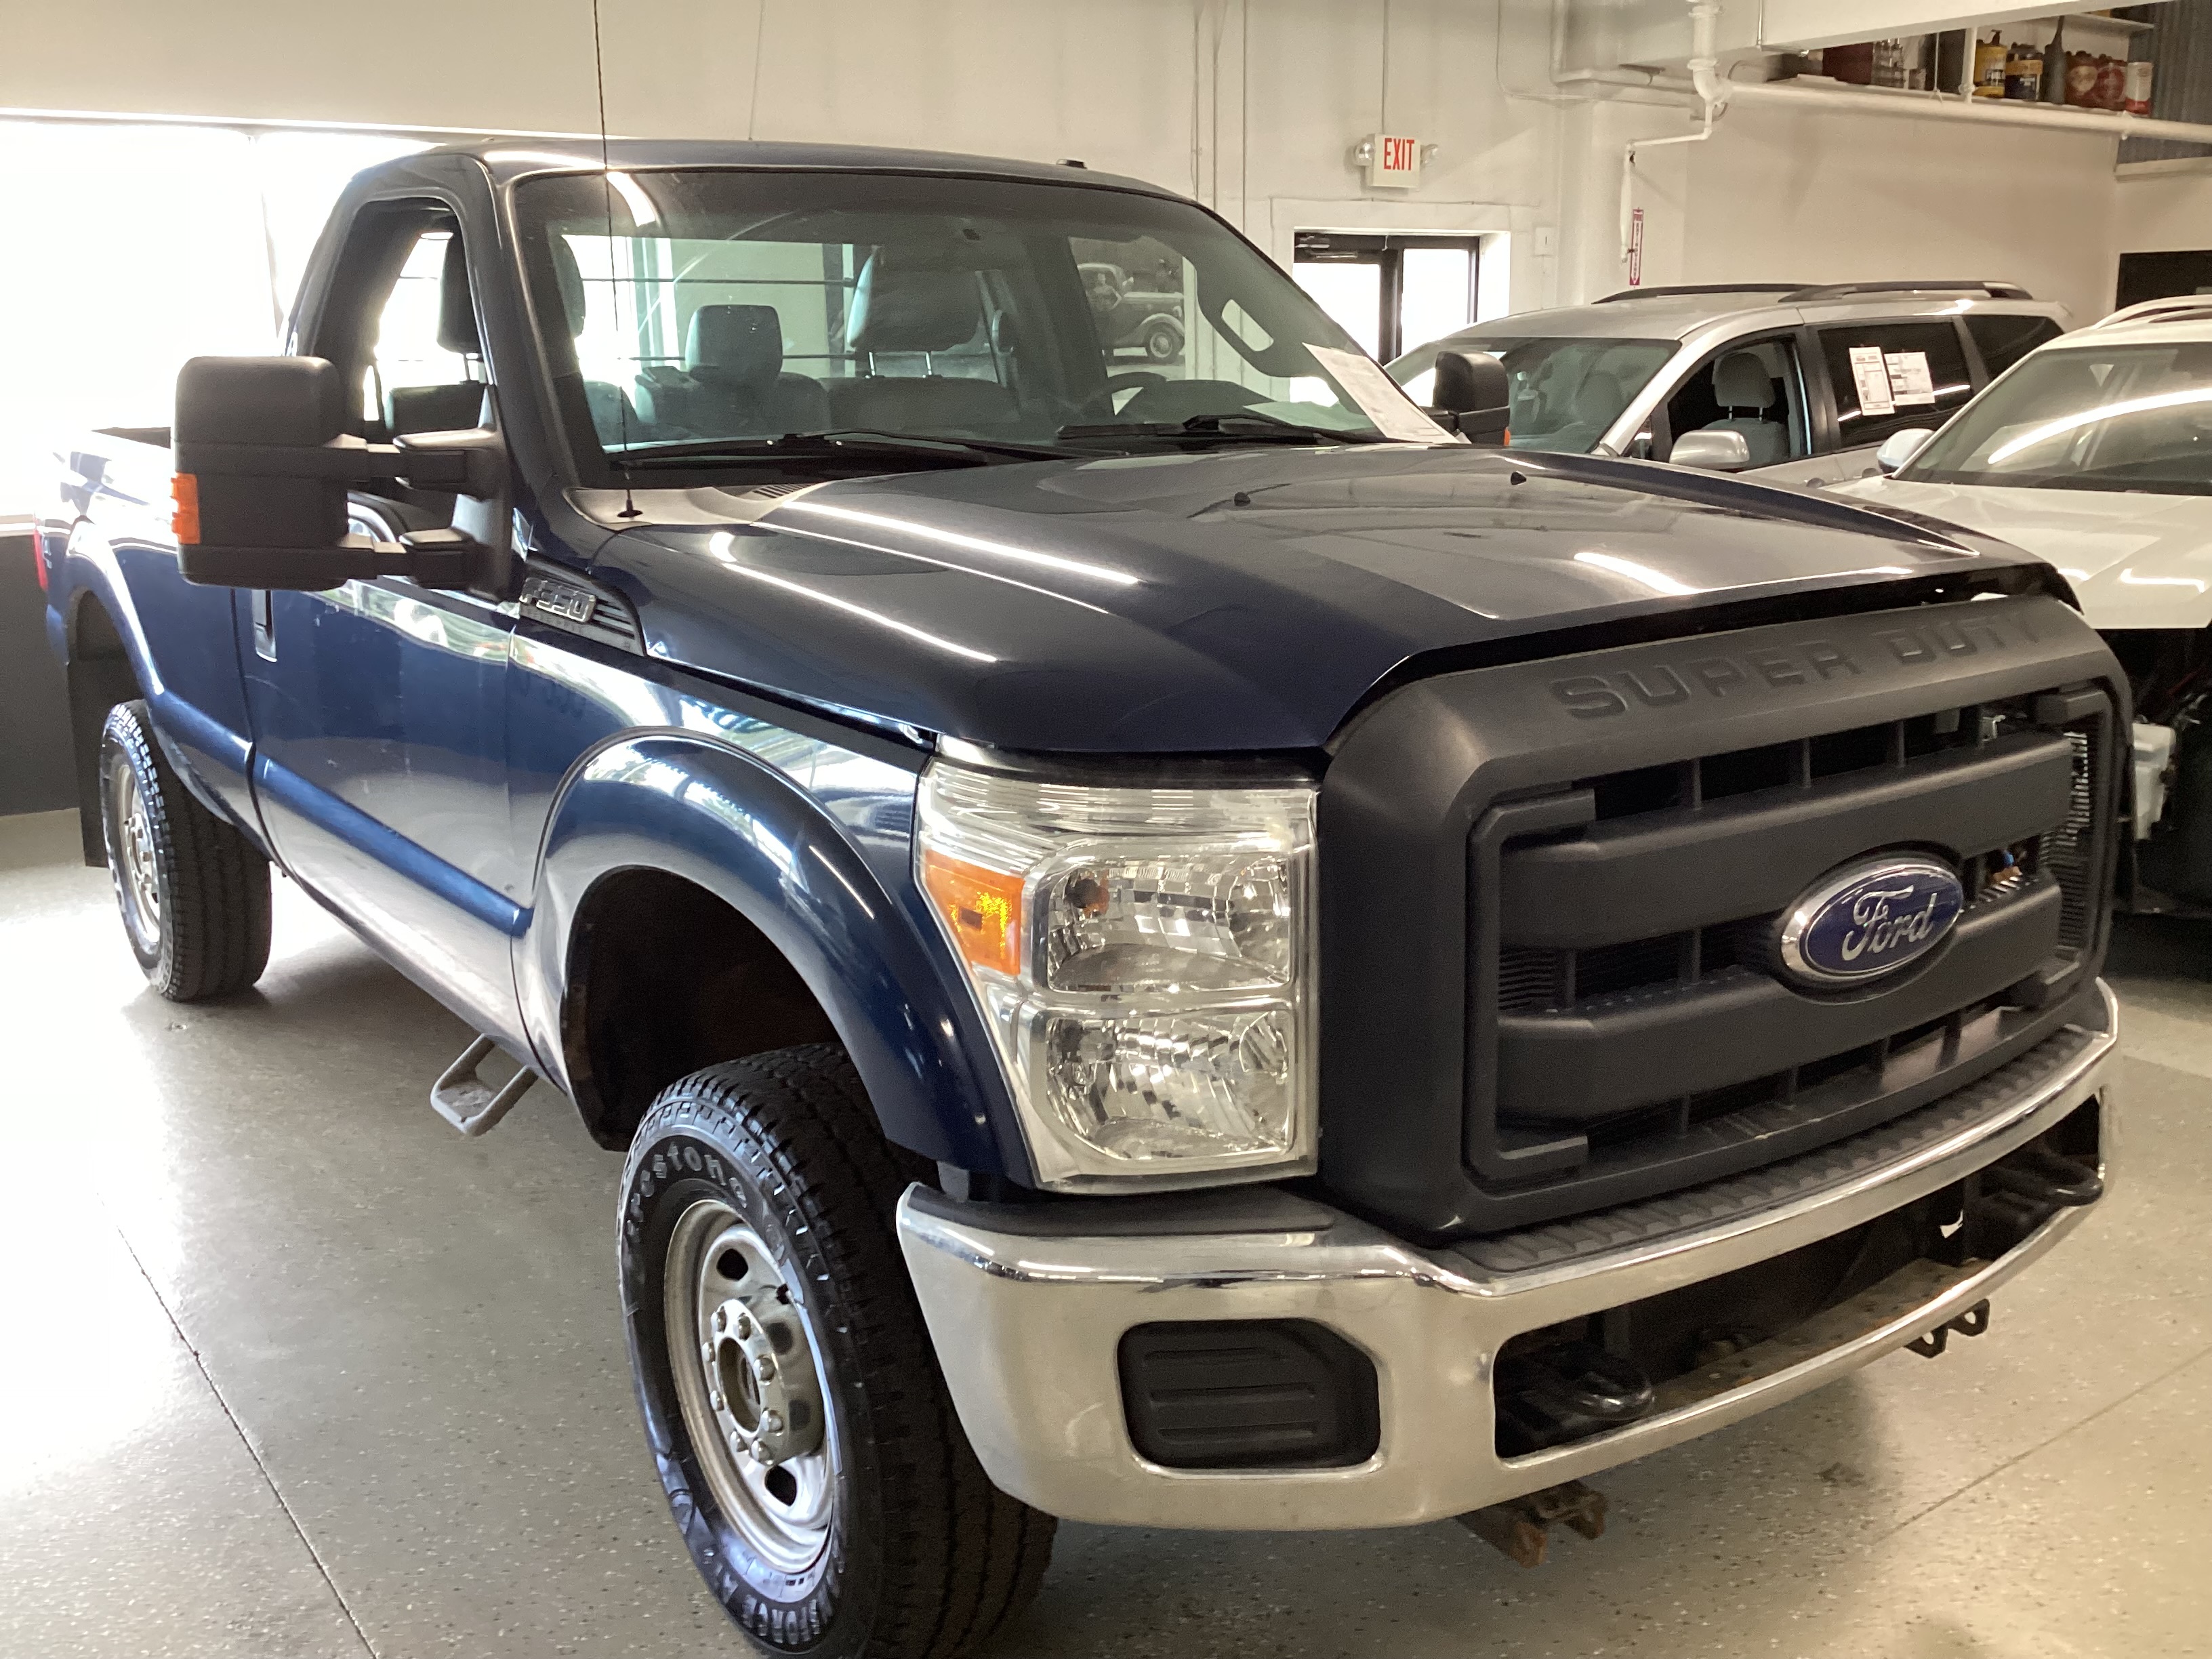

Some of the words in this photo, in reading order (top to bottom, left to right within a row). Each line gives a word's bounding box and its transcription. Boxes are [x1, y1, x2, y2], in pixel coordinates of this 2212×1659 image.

[1384, 138, 1414, 171] EXIT
[1549, 639, 1861, 719] SUPER
[1873, 613, 2040, 663] DUTY
[1841, 884, 1938, 961] Ford
